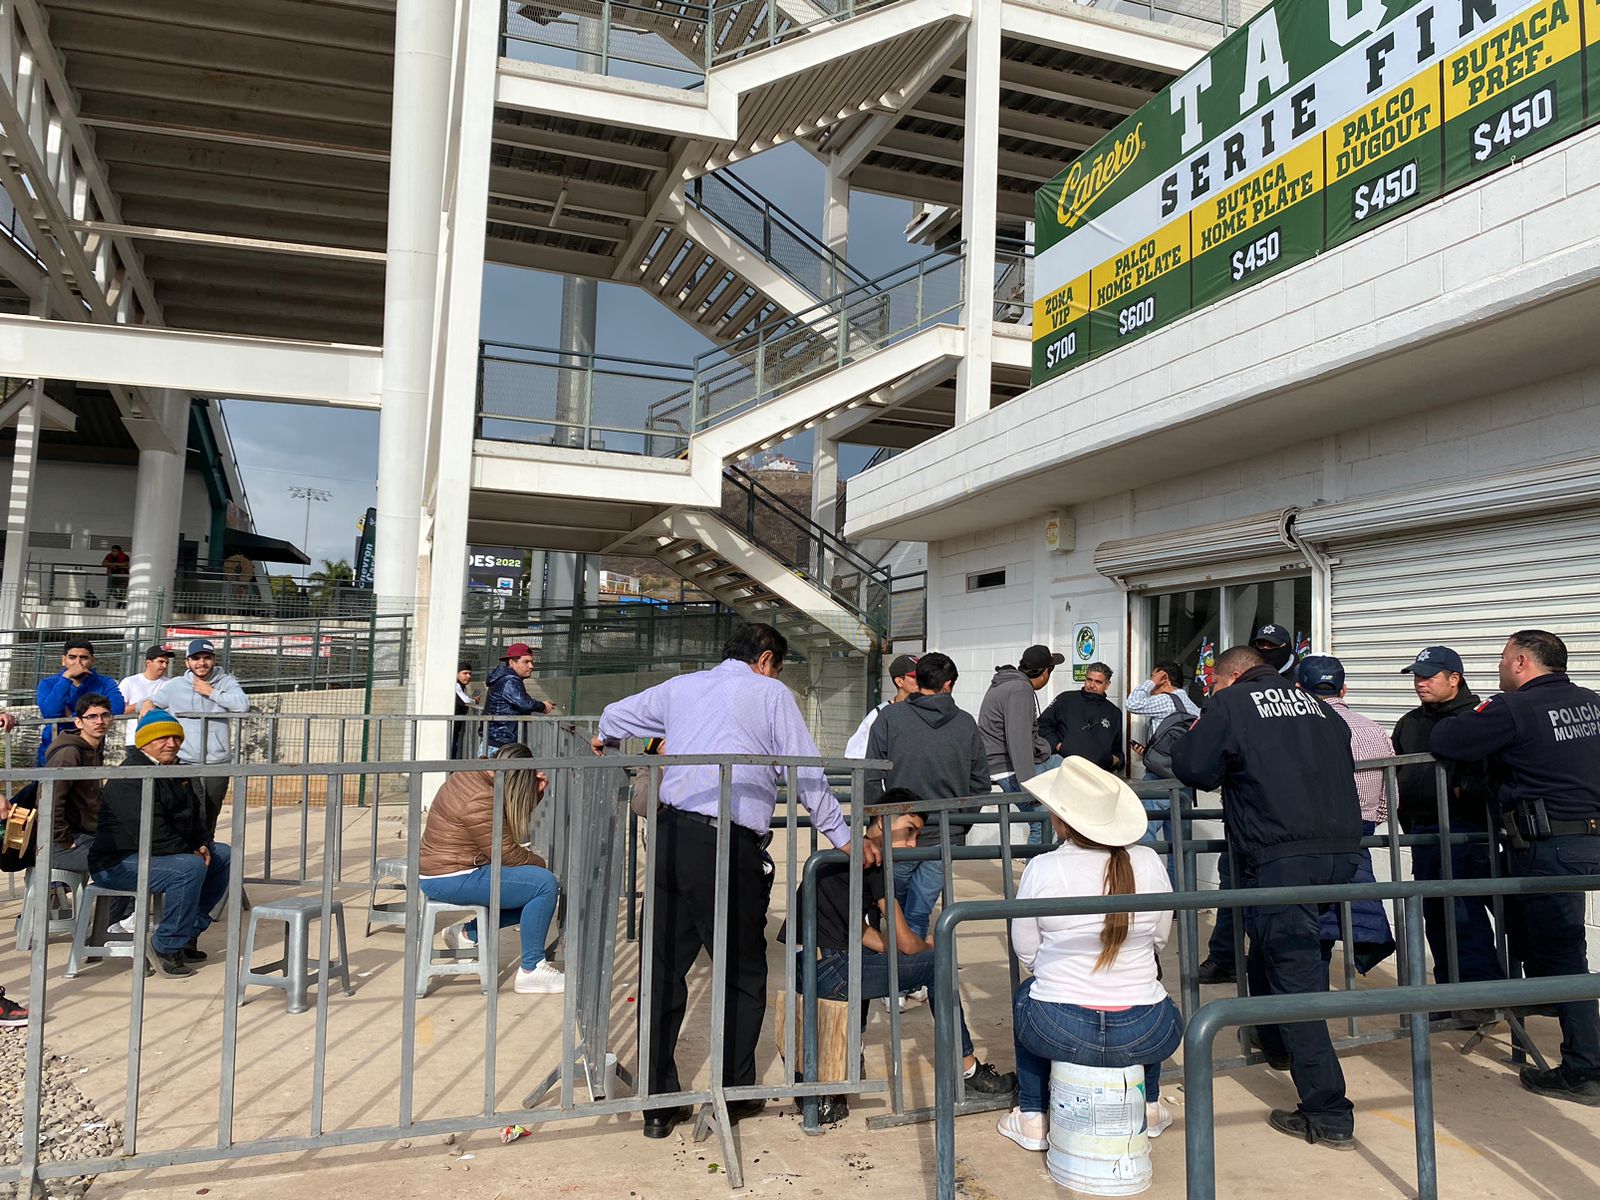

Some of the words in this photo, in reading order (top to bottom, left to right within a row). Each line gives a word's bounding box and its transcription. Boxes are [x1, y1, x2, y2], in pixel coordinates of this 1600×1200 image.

[1452, 0, 1569, 86] BUTACA
[1468, 41, 1552, 106] PREF.
[1336, 104, 1431, 178] DUGOUT
[1343, 87, 1415, 148] PALCO
[1473, 89, 1553, 162] $450
[1057, 122, 1143, 228] Cañeros
[1161, 83, 1317, 218] SERIE
[1201, 213, 1247, 251] HOME
[1253, 170, 1313, 223] PLATE
[1216, 162, 1287, 220] BUTACA
[1354, 163, 1417, 220] $450
[1097, 273, 1132, 306] HOME
[1136, 245, 1181, 286] PLATE
[1115, 239, 1156, 278] PALCO
[1233, 231, 1280, 281] $450
[1045, 286, 1074, 316] ZONA
[1052, 305, 1070, 329] VIP
[1119, 297, 1154, 335] $600
[1046, 332, 1076, 368] $700
[495, 558, 522, 568] 2022
